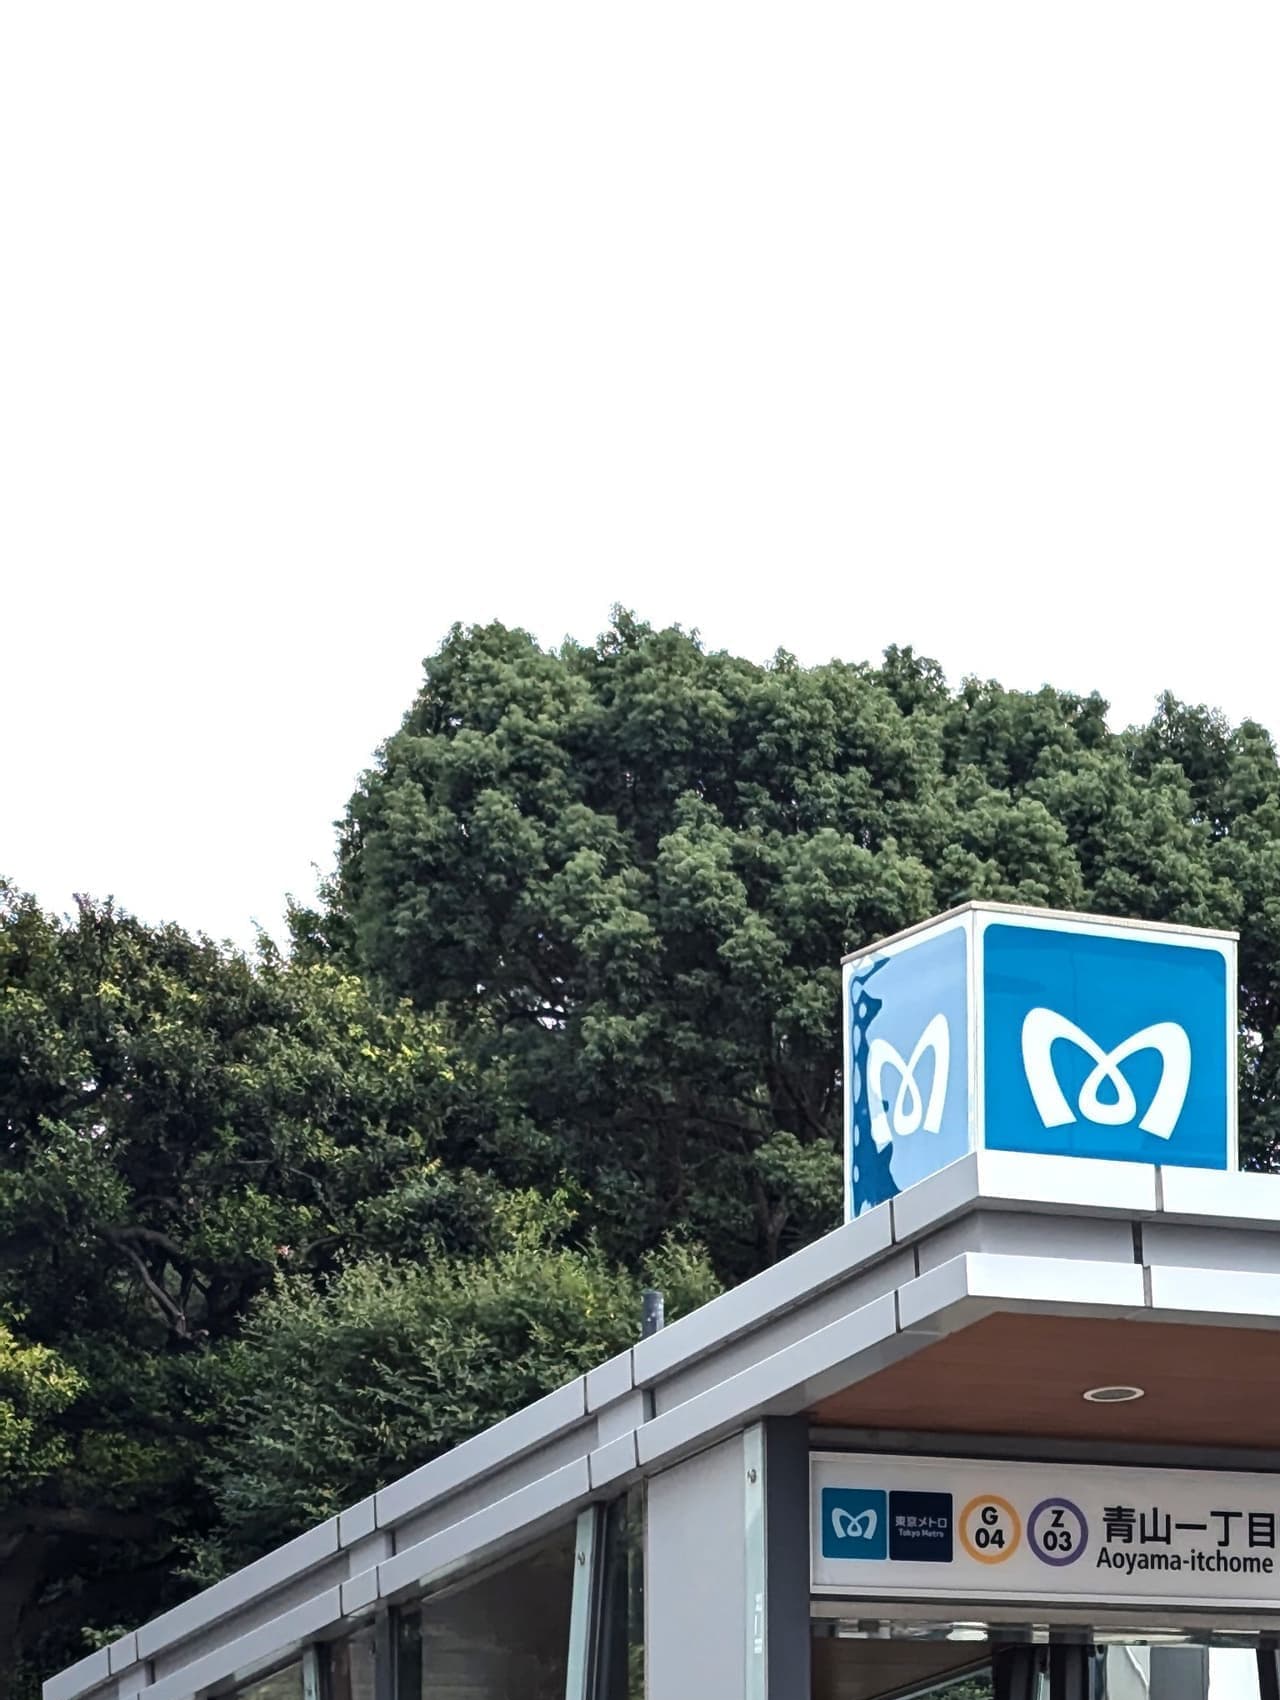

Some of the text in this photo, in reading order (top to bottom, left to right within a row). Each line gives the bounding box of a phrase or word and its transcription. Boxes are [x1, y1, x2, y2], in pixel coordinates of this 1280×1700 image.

[895, 1515, 948, 1529] 東京メトロ
[981, 1506, 999, 1526] G
[1051, 1509, 1065, 1528] Z
[898, 1527, 945, 1539] Tokyo Metro
[974, 1528, 1006, 1550] 04
[1043, 1530, 1072, 1552] 03
[1096, 1546, 1274, 1576] Aoyama-itchome
